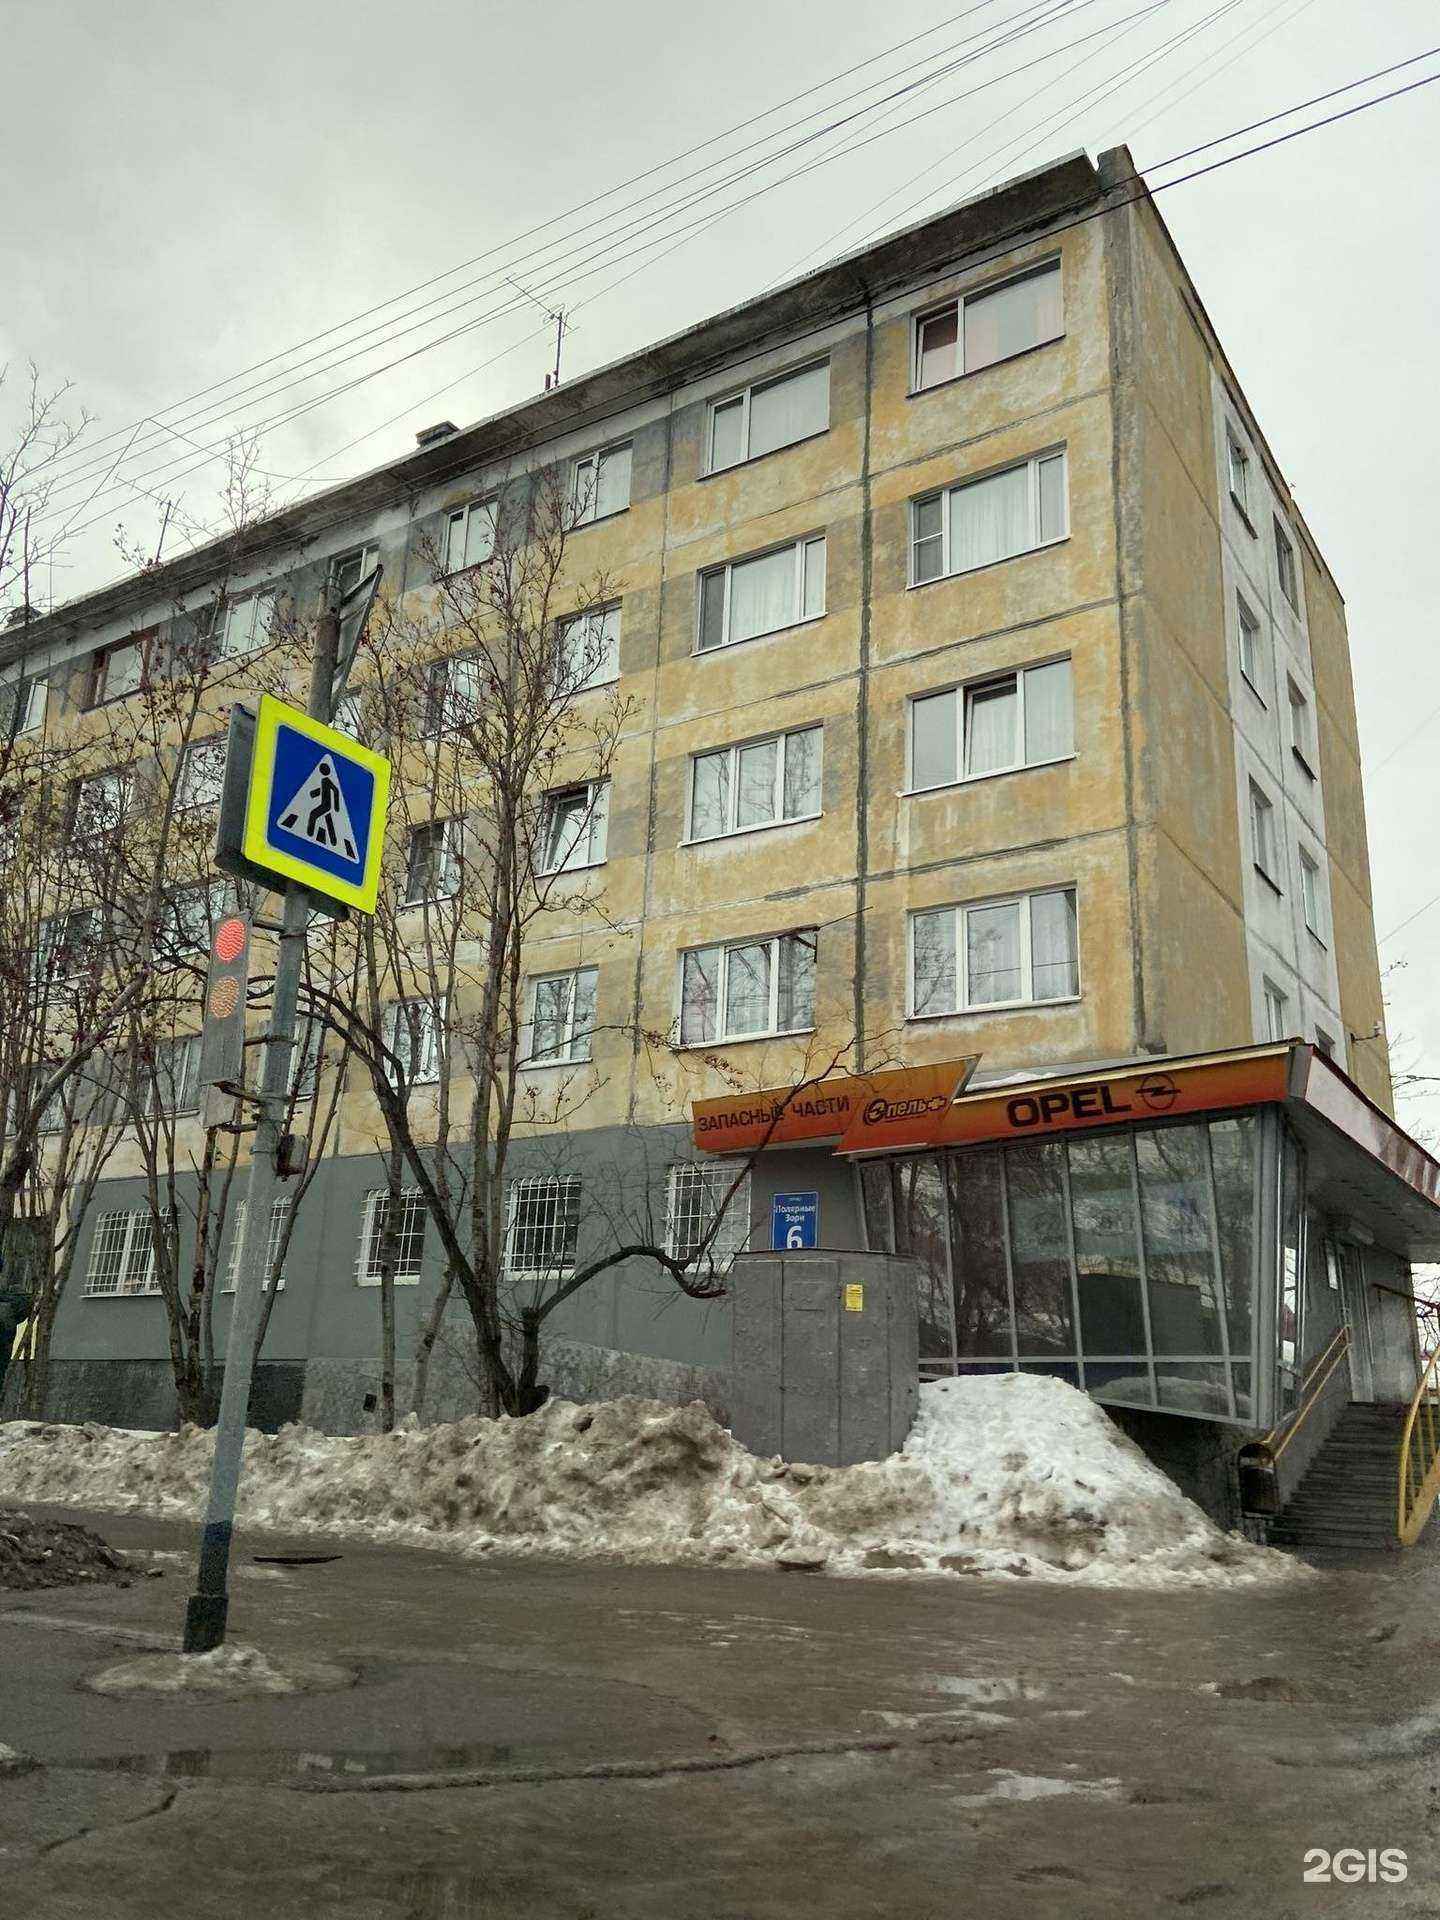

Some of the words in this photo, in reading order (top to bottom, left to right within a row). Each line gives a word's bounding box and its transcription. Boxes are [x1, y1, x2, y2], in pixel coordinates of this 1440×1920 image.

[793, 1095, 849, 1117] ЧАСТИ
[1007, 1086, 1132, 1127] OPEL
[785, 1213, 805, 1223] Зори
[786, 1226, 803, 1249] 6
